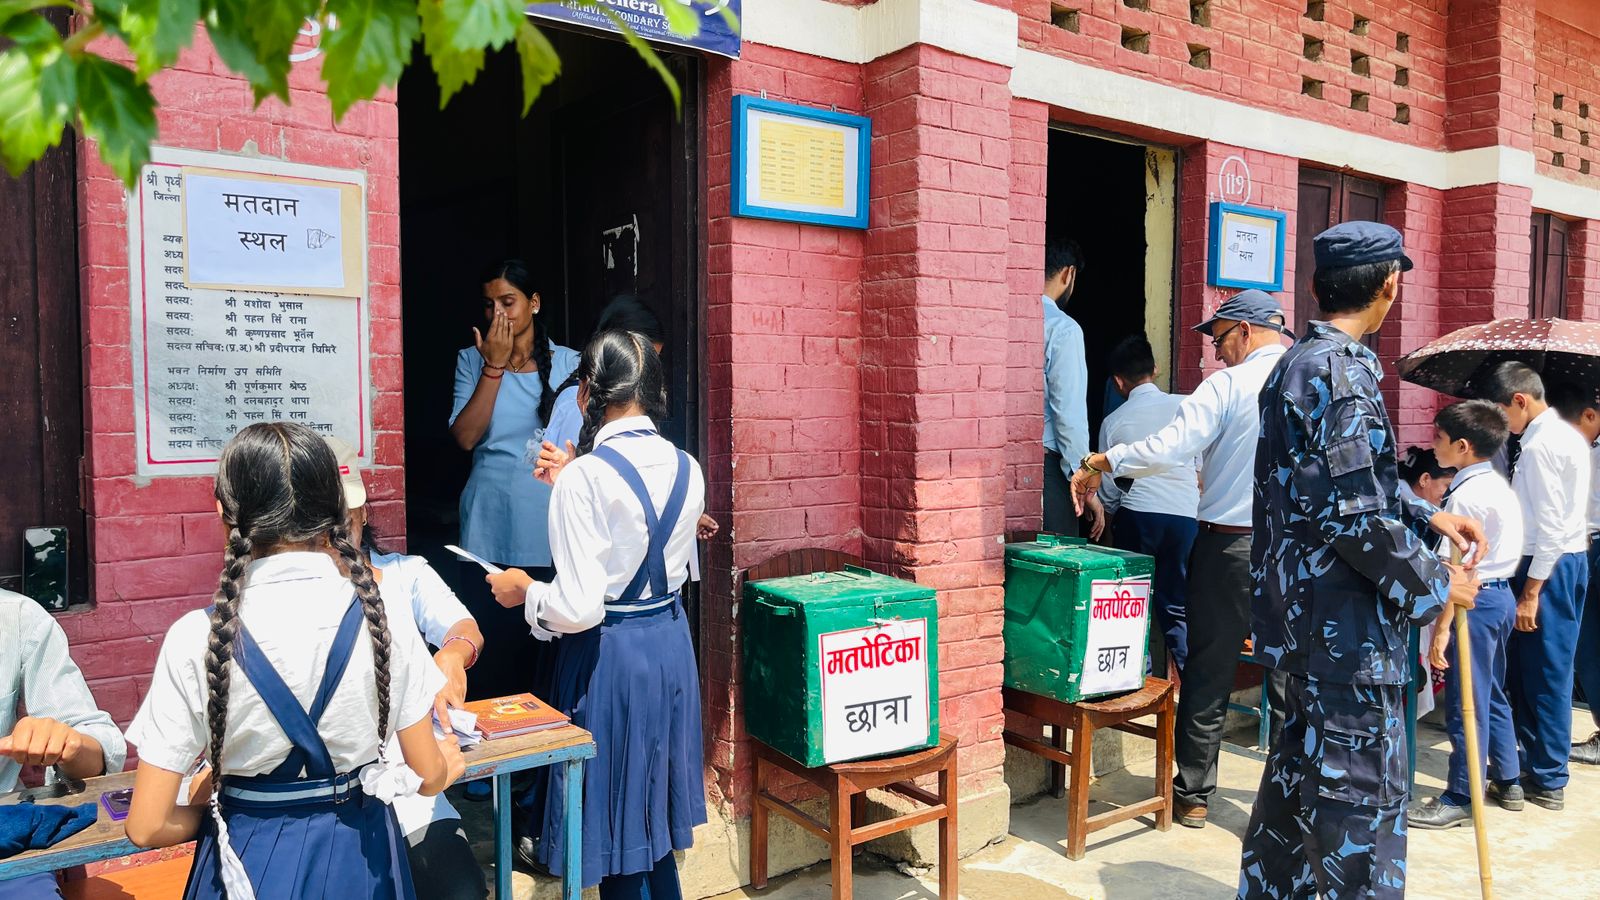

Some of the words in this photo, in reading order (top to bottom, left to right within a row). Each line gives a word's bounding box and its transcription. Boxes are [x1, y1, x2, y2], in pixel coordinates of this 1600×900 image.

[146, 170, 158, 187] श्री
[164, 173, 182, 192] पृथ्व
[1226, 173, 1244, 195] 119
[222, 193, 299, 217] मतदान
[238, 231, 288, 252] स्थल
[1236, 230, 1258, 243] मतदान
[1239, 250, 1254, 262] स्थल
[166, 296, 193, 305] सदस्य:
[225, 297, 237, 308] श्री
[244, 298, 271, 309] यशोदा
[278, 301, 303, 312] भुसाल
[166, 312, 194, 321] सदस्य:
[225, 313, 237, 323] श्री
[244, 314, 264, 324] पहल
[289, 316, 307, 325] राना
[166, 327, 194, 337] सदस्य:
[225, 327, 237, 337] श्री
[245, 330, 286, 341] कृष्णप्रसाद
[167, 342, 191, 351] सदस्य
[255, 342, 266, 353] श्री
[269, 343, 305, 353] प्रदीपराज
[168, 367, 190, 376] भवन
[198, 364, 226, 376] निर्माण
[234, 368, 248, 376] उप
[255, 365, 282, 376] समिति
[225, 380, 236, 391] श्री
[244, 380, 282, 394] पूर्णकुमार
[168, 397, 196, 405] सदस्य:
[225, 395, 236, 405] श्री
[243, 396, 284, 408] दलबहादुर
[291, 397, 310, 405] थापा
[169, 413, 196, 422] सदस्य:
[225, 410, 237, 420] श्री
[244, 411, 264, 420] पहल
[289, 411, 307, 419] राना
[169, 426, 196, 435] सदस्य:
[225, 425, 237, 434] श्री
[168, 439, 192, 449] सदस्य
[1093, 590, 1146, 621] मतपेटिका
[827, 633, 921, 675] मतपेटिका
[1098, 645, 1130, 673] छात्र
[844, 695, 912, 733] छात्रा
